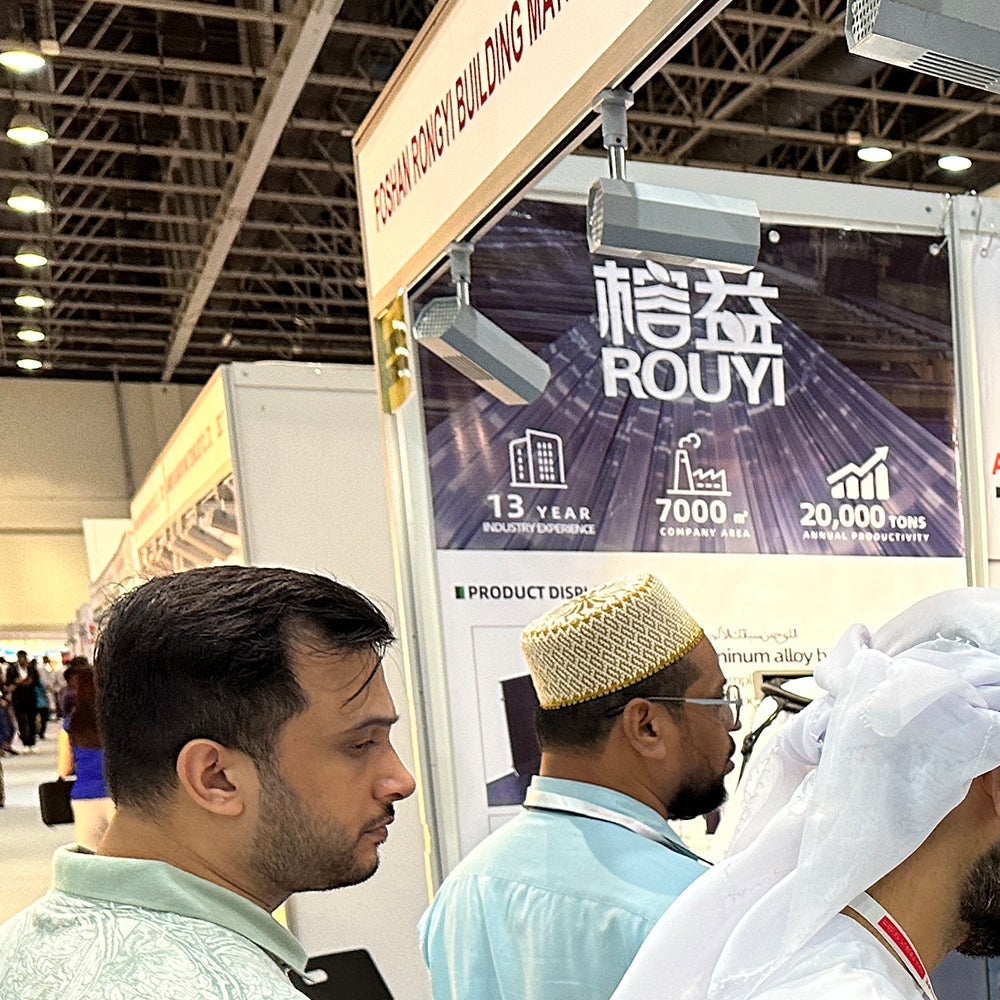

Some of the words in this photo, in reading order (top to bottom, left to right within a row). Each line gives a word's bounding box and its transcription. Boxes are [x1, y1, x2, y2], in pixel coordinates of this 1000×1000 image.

[374, 145, 411, 233] FOSHAN
[411, 89, 456, 185] RONGYI
[456, 1, 524, 133] BUILDING
[601, 346, 786, 406] ROUYI
[487, 494, 525, 519] 13
[536, 505, 591, 521] YEAR
[656, 498, 727, 524] 7000
[800, 502, 886, 529] 20,000
[888, 515, 927, 530] TONS
[482, 521, 536, 535] INDUSTRY
[537, 522, 596, 536] EXPERIENCE
[660, 527, 716, 538] COMPANY
[721, 528, 750, 538] AREA
[803, 530, 847, 541] ANNUAL
[851, 531, 930, 543] PRODUCTIVITY
[468, 585, 545, 600] PRODUCT
[774, 647, 813, 665] alloy
